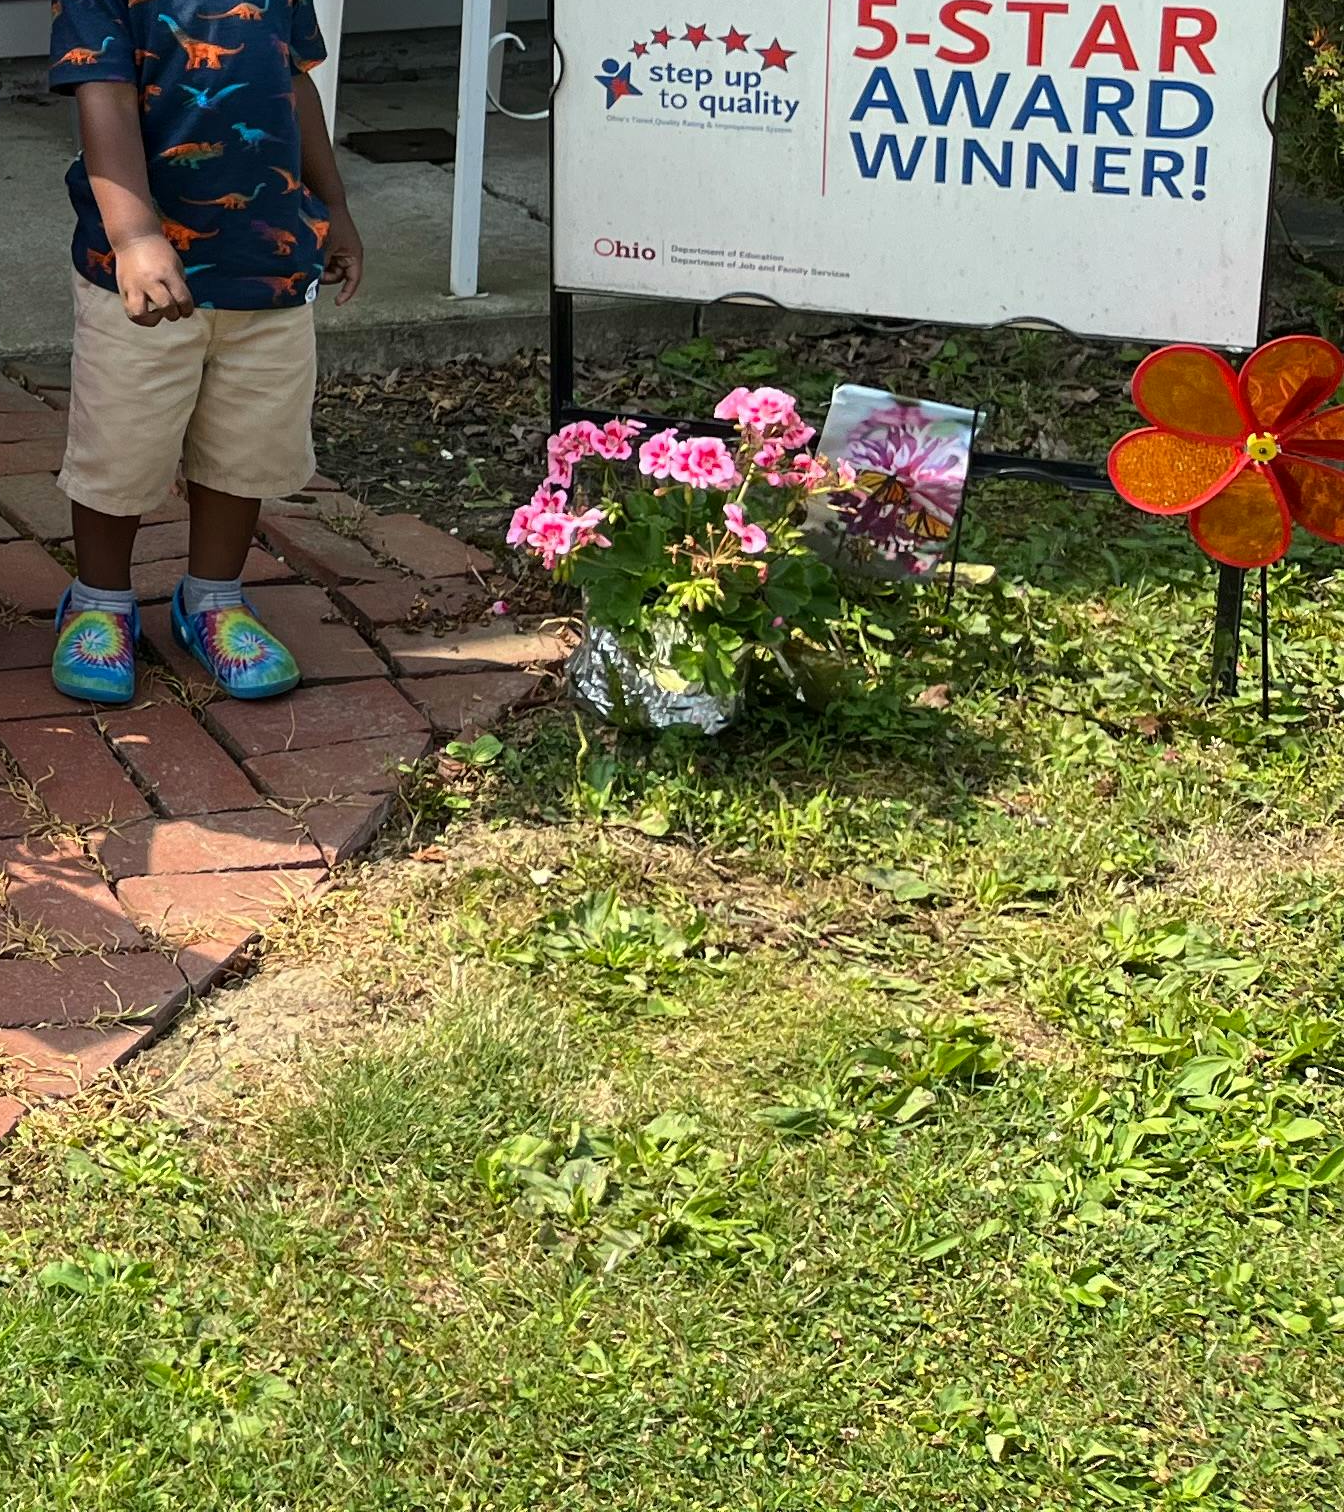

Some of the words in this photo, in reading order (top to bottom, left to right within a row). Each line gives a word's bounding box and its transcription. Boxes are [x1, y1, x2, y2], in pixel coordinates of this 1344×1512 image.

[649, 63, 712, 91] step
[725, 70, 761, 94] up
[659, 89, 687, 109] to
[698, 90, 800, 123] quality
[849, 66, 1214, 140] AWARD
[655, 118, 680, 127] Quality
[849, 132, 1208, 201] WINNER!
[594, 238, 656, 261] Ohio
[671, 245, 725, 257] Department
[727, 249, 736, 257] of
[739, 251, 784, 261] Education
[671, 256, 725, 267] Department
[727, 261, 736, 269] of
[738, 262, 756, 270] Job
[758, 264, 775, 272] and
[777, 265, 808, 276] Family
[811, 269, 850, 278] Services
